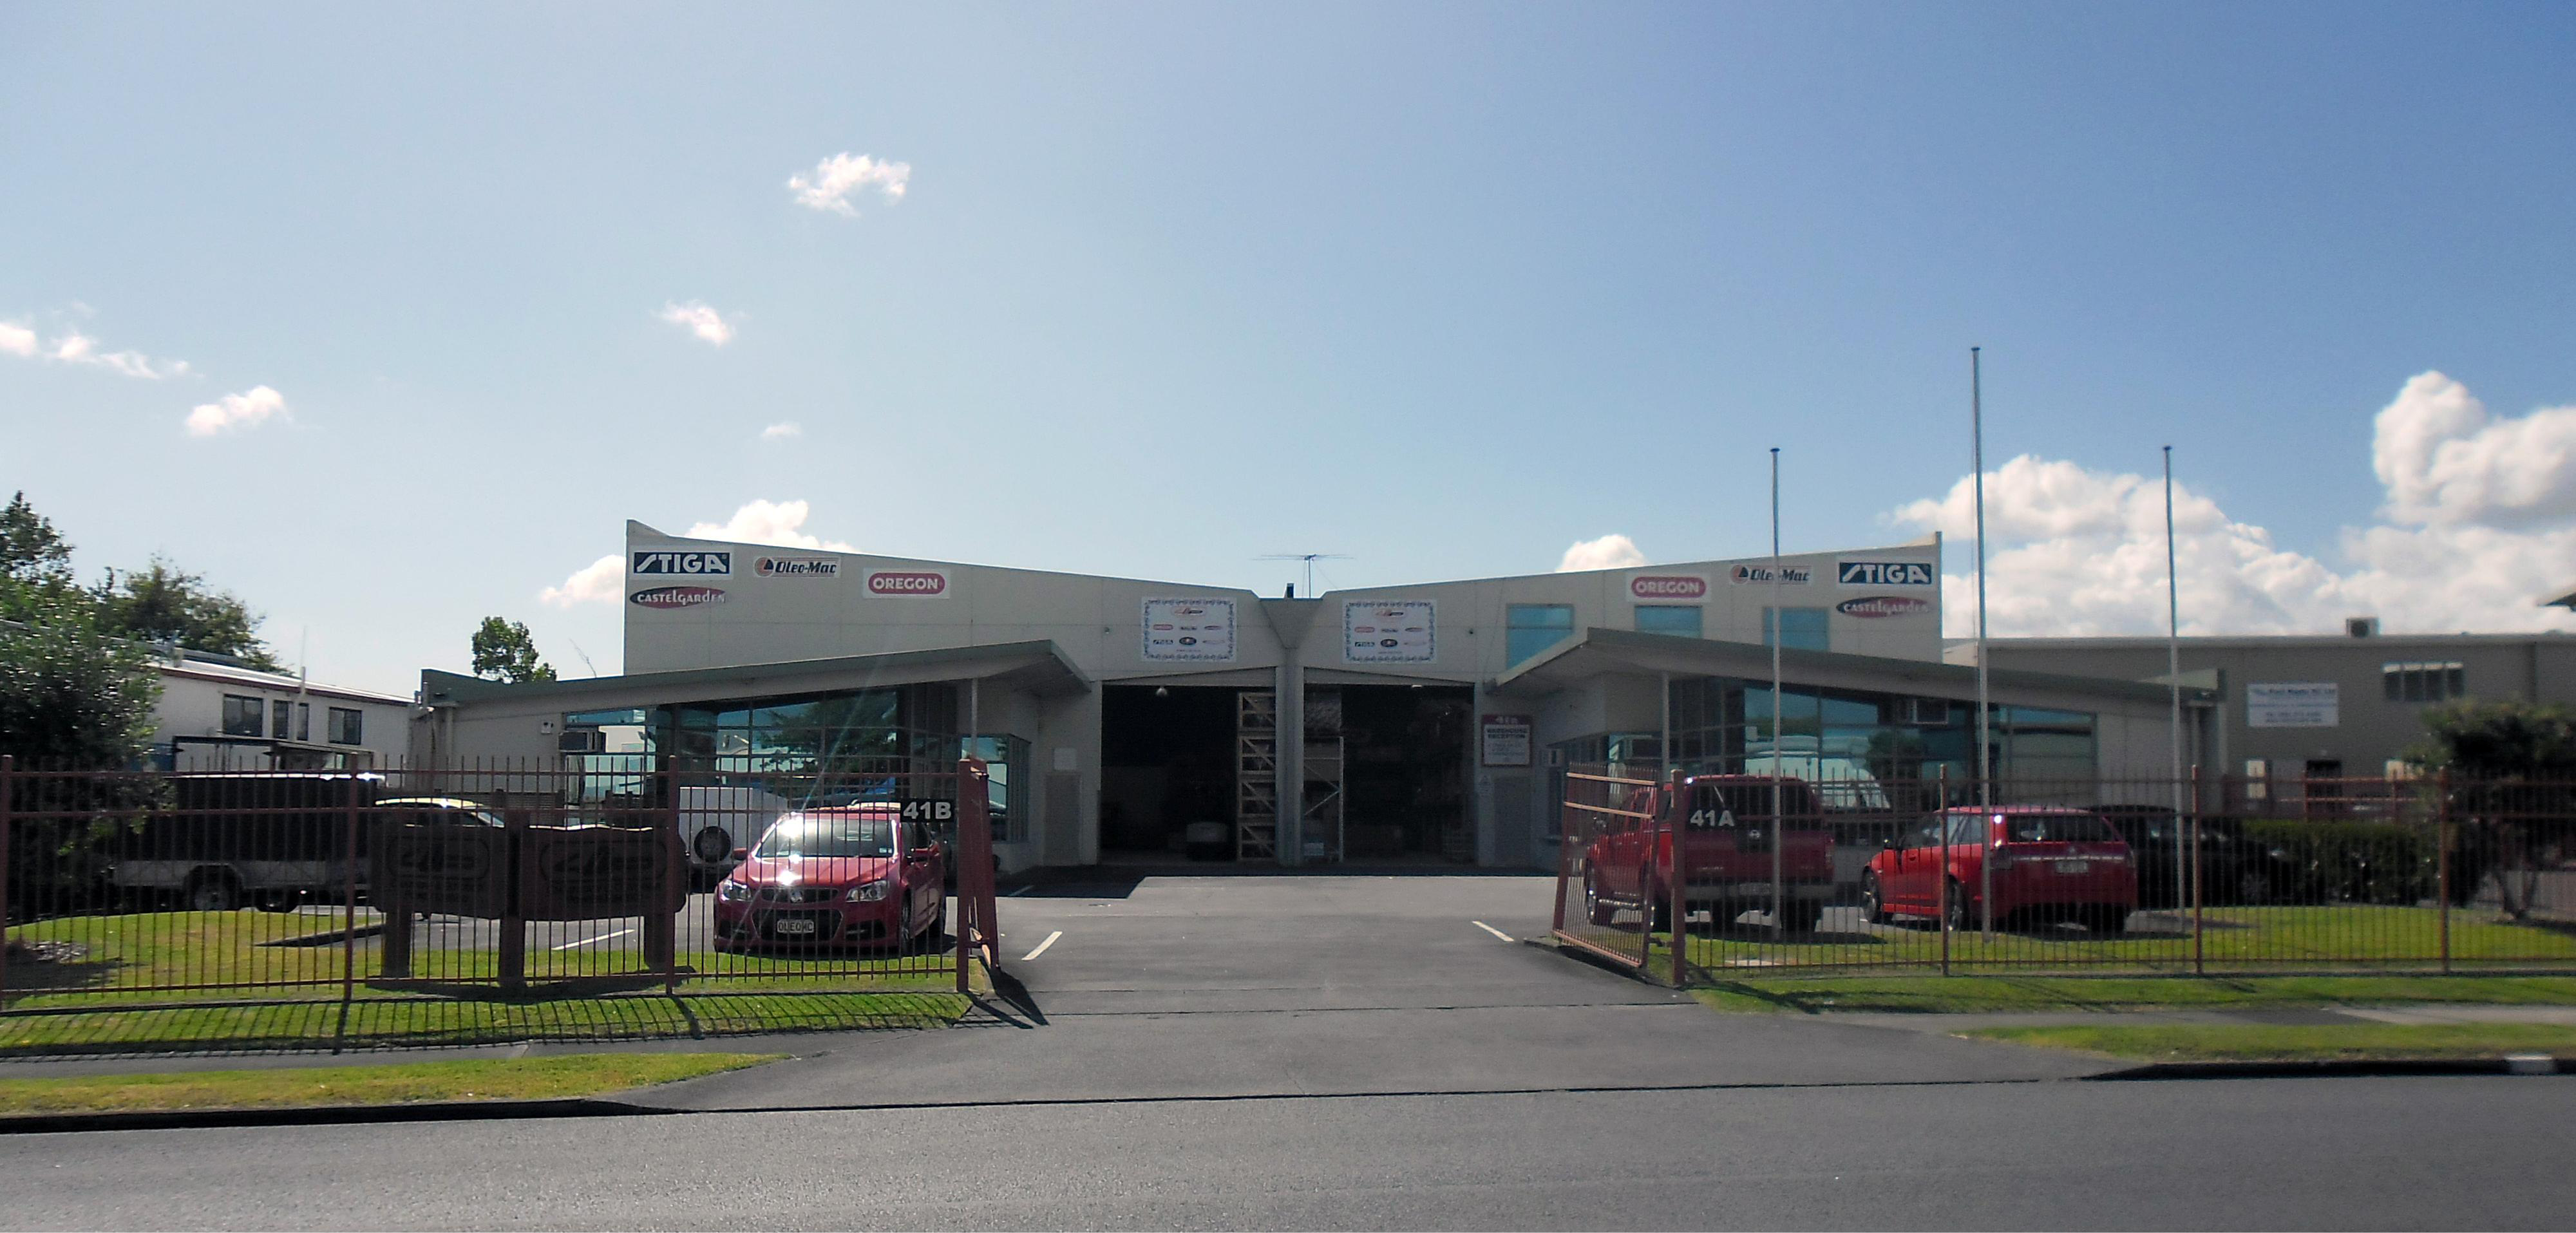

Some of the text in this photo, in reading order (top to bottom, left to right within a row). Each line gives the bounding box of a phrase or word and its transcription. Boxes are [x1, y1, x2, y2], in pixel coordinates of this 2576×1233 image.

[636, 553, 727, 573] STIGA
[775, 561, 837, 574] Oleo-Mac
[1842, 565, 1929, 583] STIGA
[873, 578, 938, 590] OREGON
[1636, 581, 1699, 593] OREGON
[903, 802, 951, 820] 41B
[1689, 809, 1735, 827] 41A
